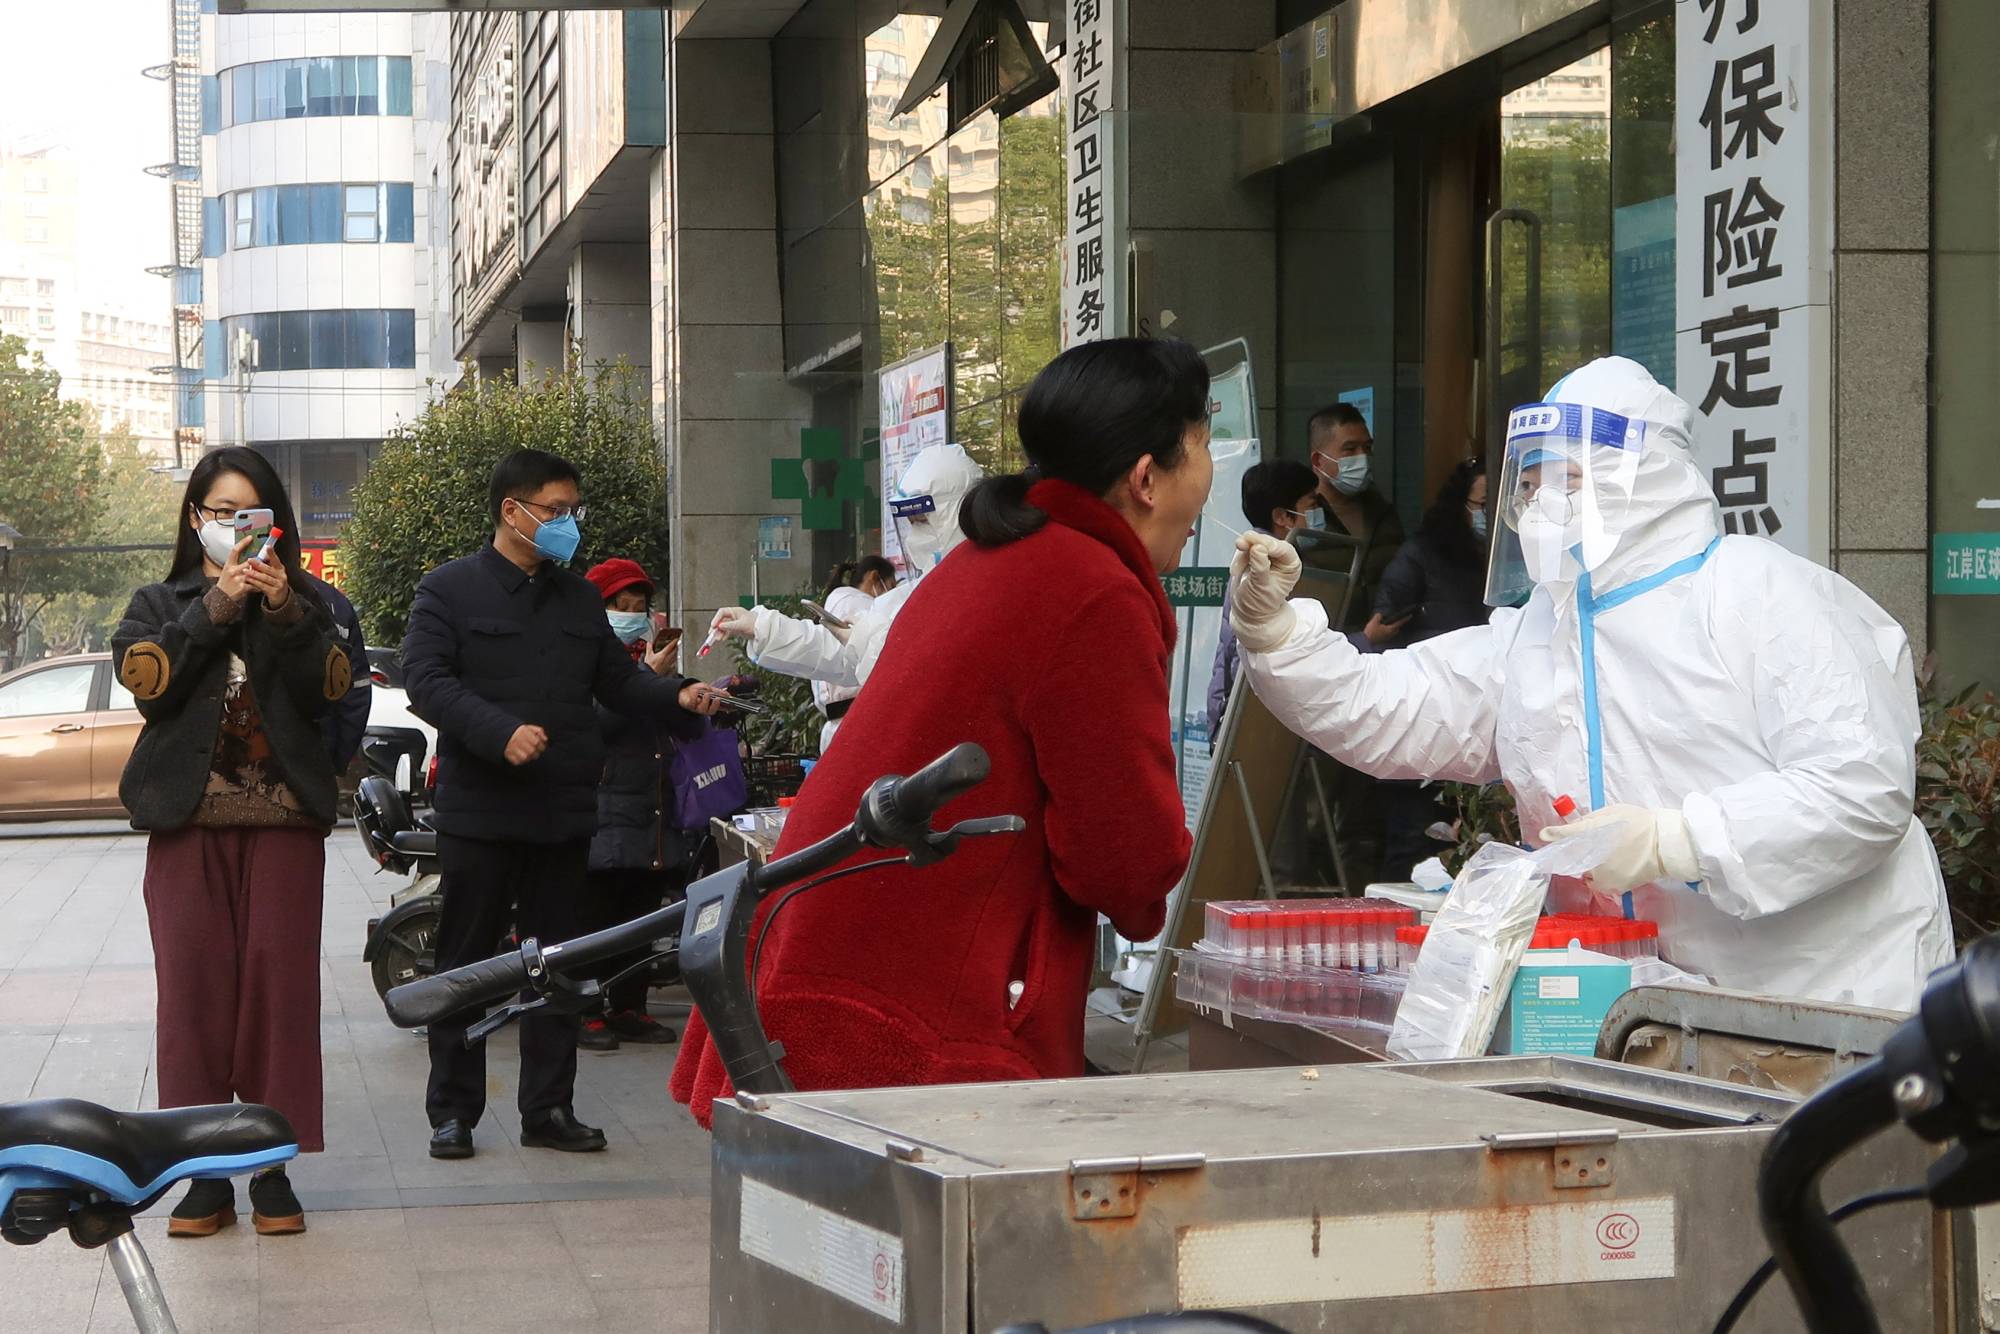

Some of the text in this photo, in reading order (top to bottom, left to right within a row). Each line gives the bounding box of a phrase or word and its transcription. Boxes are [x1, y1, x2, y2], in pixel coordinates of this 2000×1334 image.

[1073, 0, 1104, 342] 街社区卫生服务
